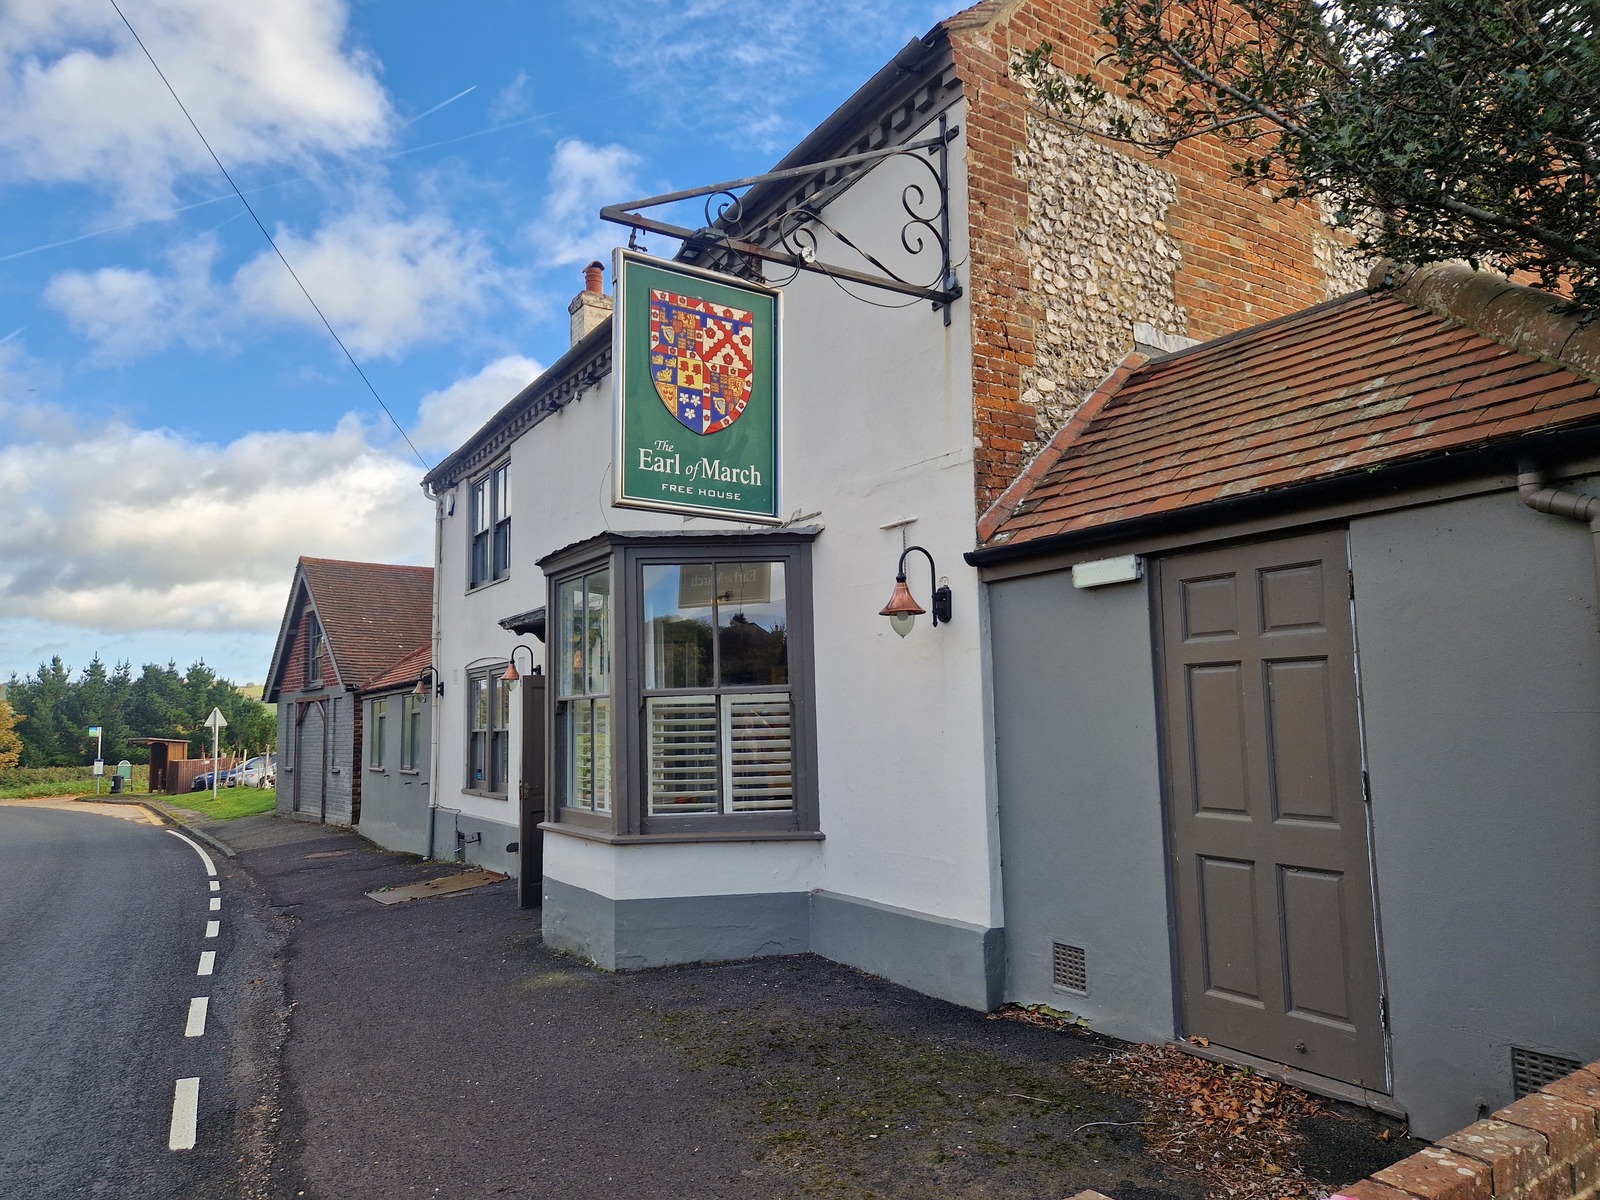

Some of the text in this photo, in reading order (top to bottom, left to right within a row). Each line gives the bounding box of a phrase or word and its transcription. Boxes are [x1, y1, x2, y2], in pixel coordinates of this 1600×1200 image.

[654, 439, 674, 453] The
[638, 447, 762, 486] Earl of March
[661, 483, 741, 501] FREE HOUSE
